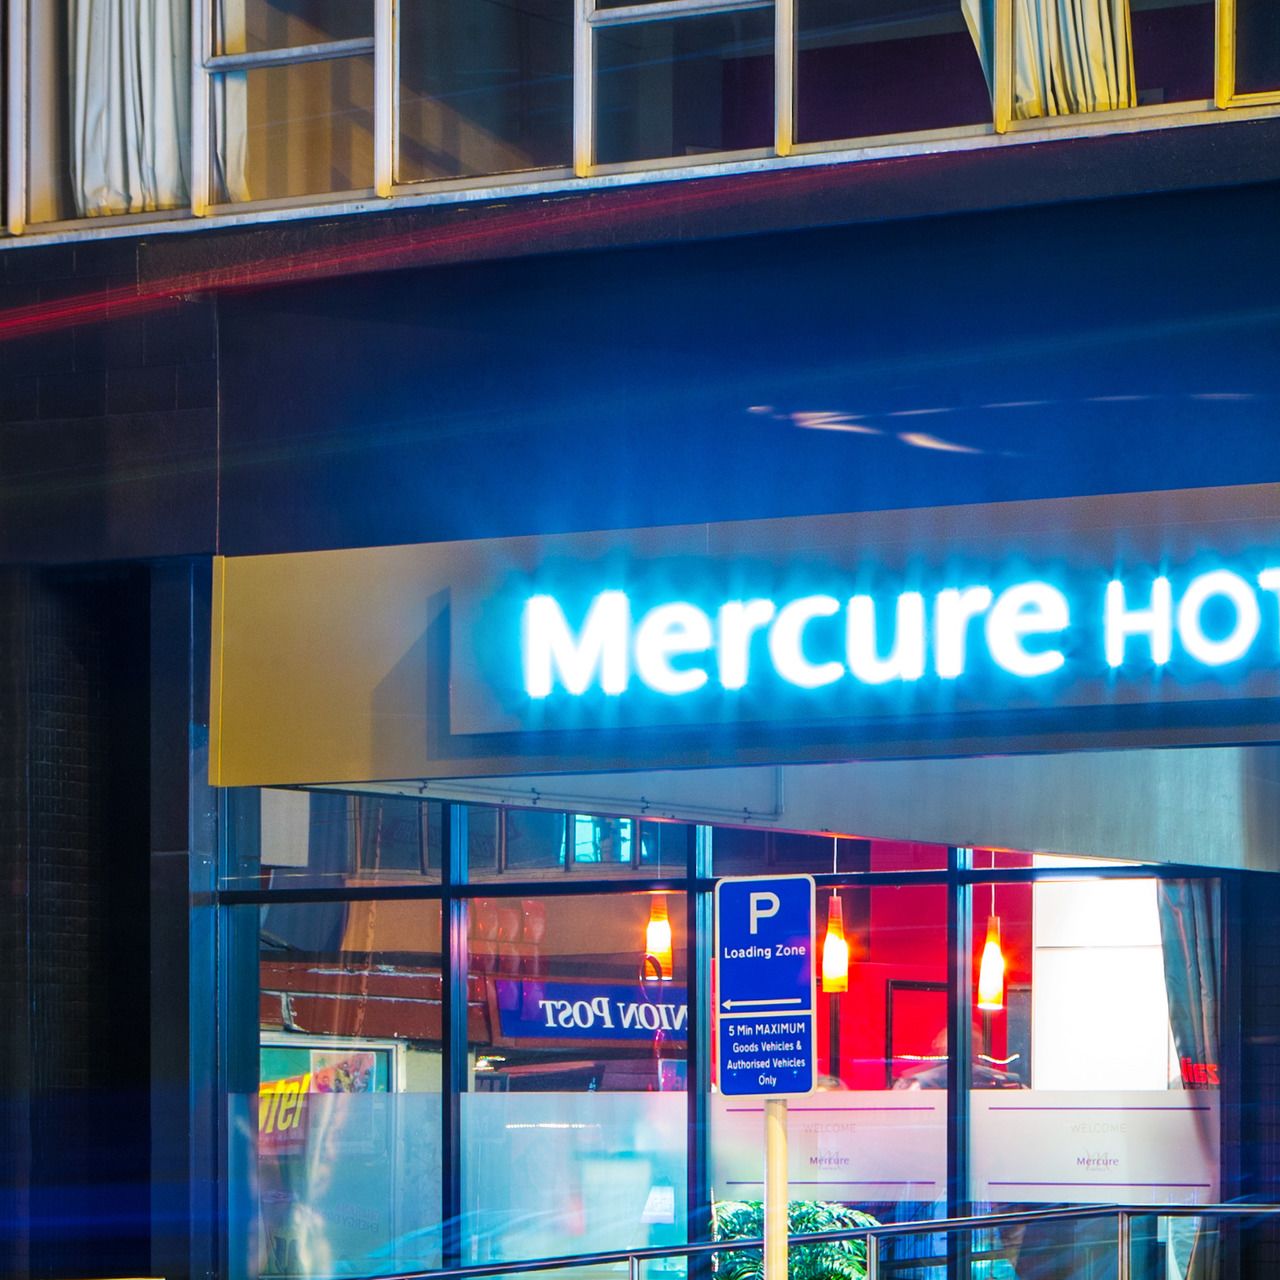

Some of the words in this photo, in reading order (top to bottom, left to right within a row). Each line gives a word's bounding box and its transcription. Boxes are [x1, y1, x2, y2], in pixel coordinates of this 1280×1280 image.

[522, 580, 1070, 699] Mercure
[749, 891, 781, 935] P
[724, 945, 772, 960] Loading
[775, 944, 806, 957] Zone
[728, 1025, 735, 1036] 5
[737, 1024, 753, 1036] Min
[755, 1022, 806, 1035] MAXIMUM
[733, 1042, 759, 1053] Goods
[761, 1040, 794, 1052] Vehicles
[796, 1039, 802, 1051] &
[727, 1058, 770, 1070] Authorised
[773, 1056, 806, 1069] Vehicles
[758, 1075, 777, 1087] Only
[1071, 1122, 1128, 1134] WELCOME
[809, 1156, 850, 1165] Mercure
[1076, 1157, 1119, 1166] Mercure
